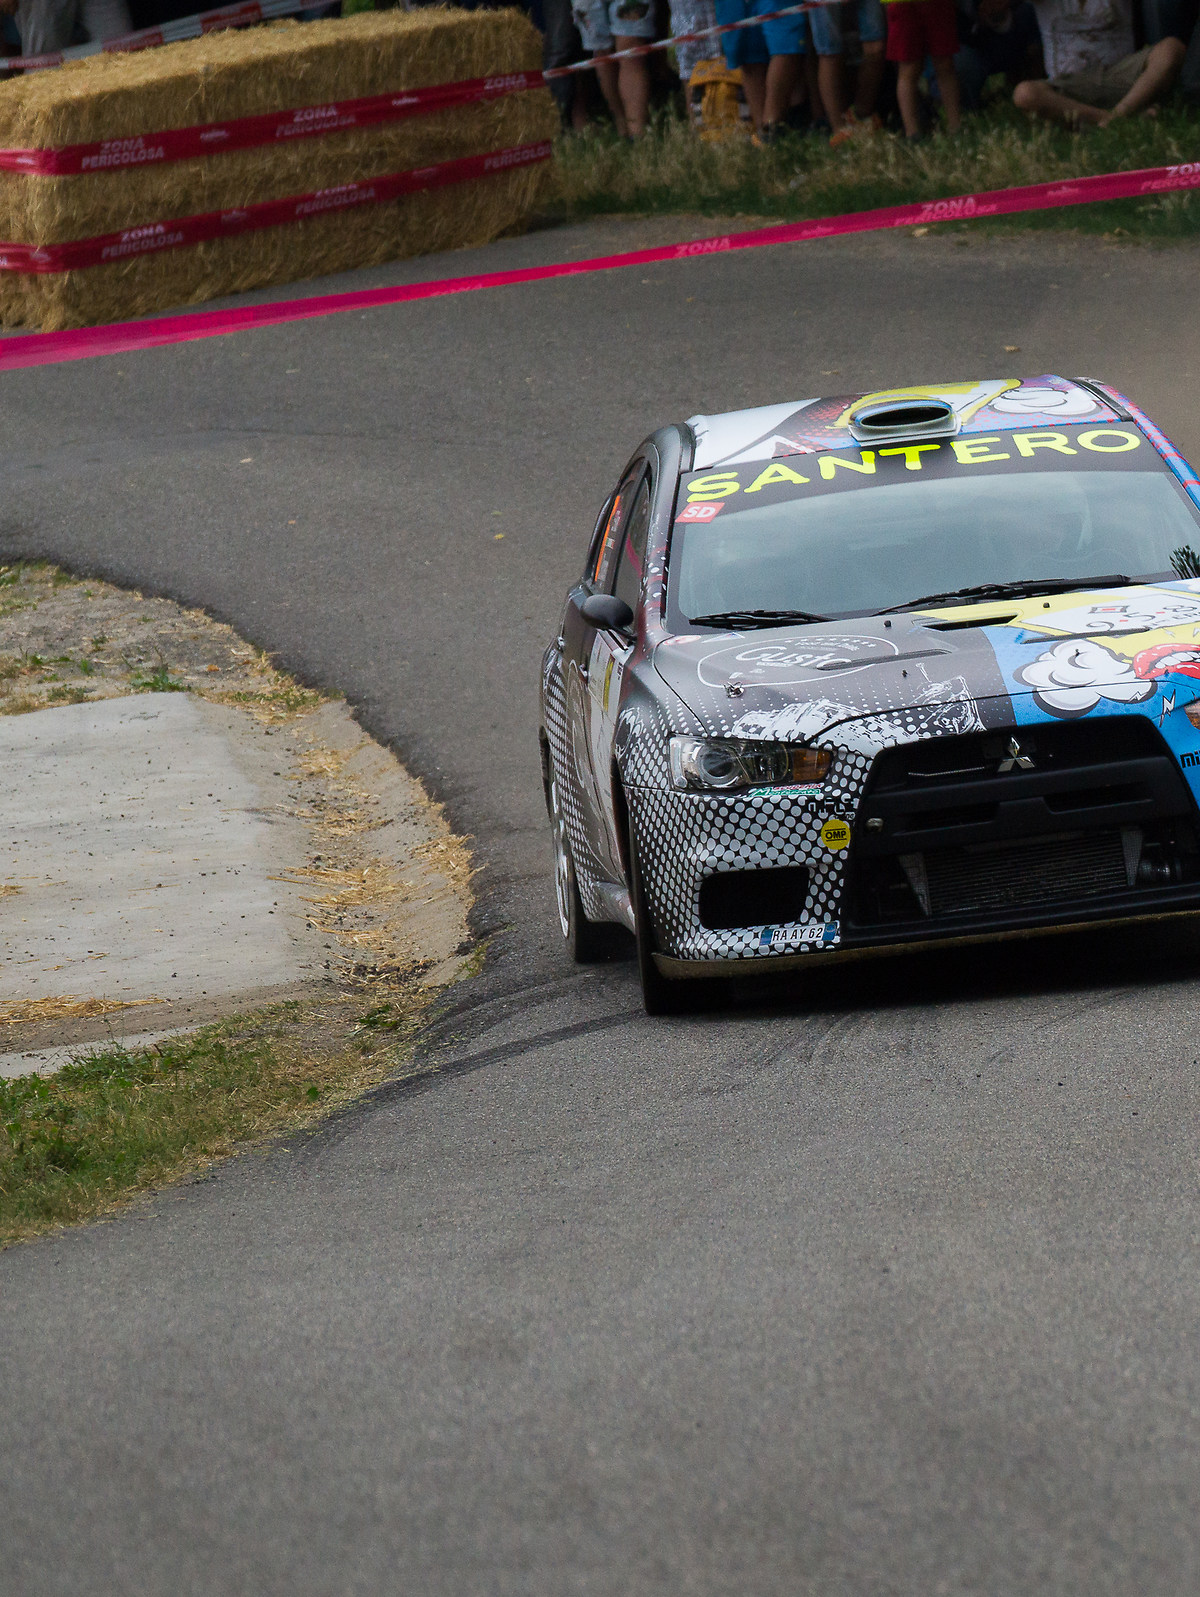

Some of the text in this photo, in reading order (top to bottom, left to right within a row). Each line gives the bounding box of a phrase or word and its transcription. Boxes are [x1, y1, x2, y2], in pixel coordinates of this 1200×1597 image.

[293, 105, 338, 122] ZONA
[101, 136, 145, 154] ZONA
[81, 147, 165, 169] PERICOLOSA
[295, 188, 375, 215] PERICOLOSA
[921, 197, 977, 215] ZONA
[121, 224, 165, 242] ZONA
[101, 231, 184, 259] PERICOLOSA
[674, 237, 731, 259] ZONA
[687, 429, 1142, 503] SANTERO
[683, 505, 717, 520] SD
[825, 831, 847, 840] OMP
[772, 927, 824, 941] RA AY 62
